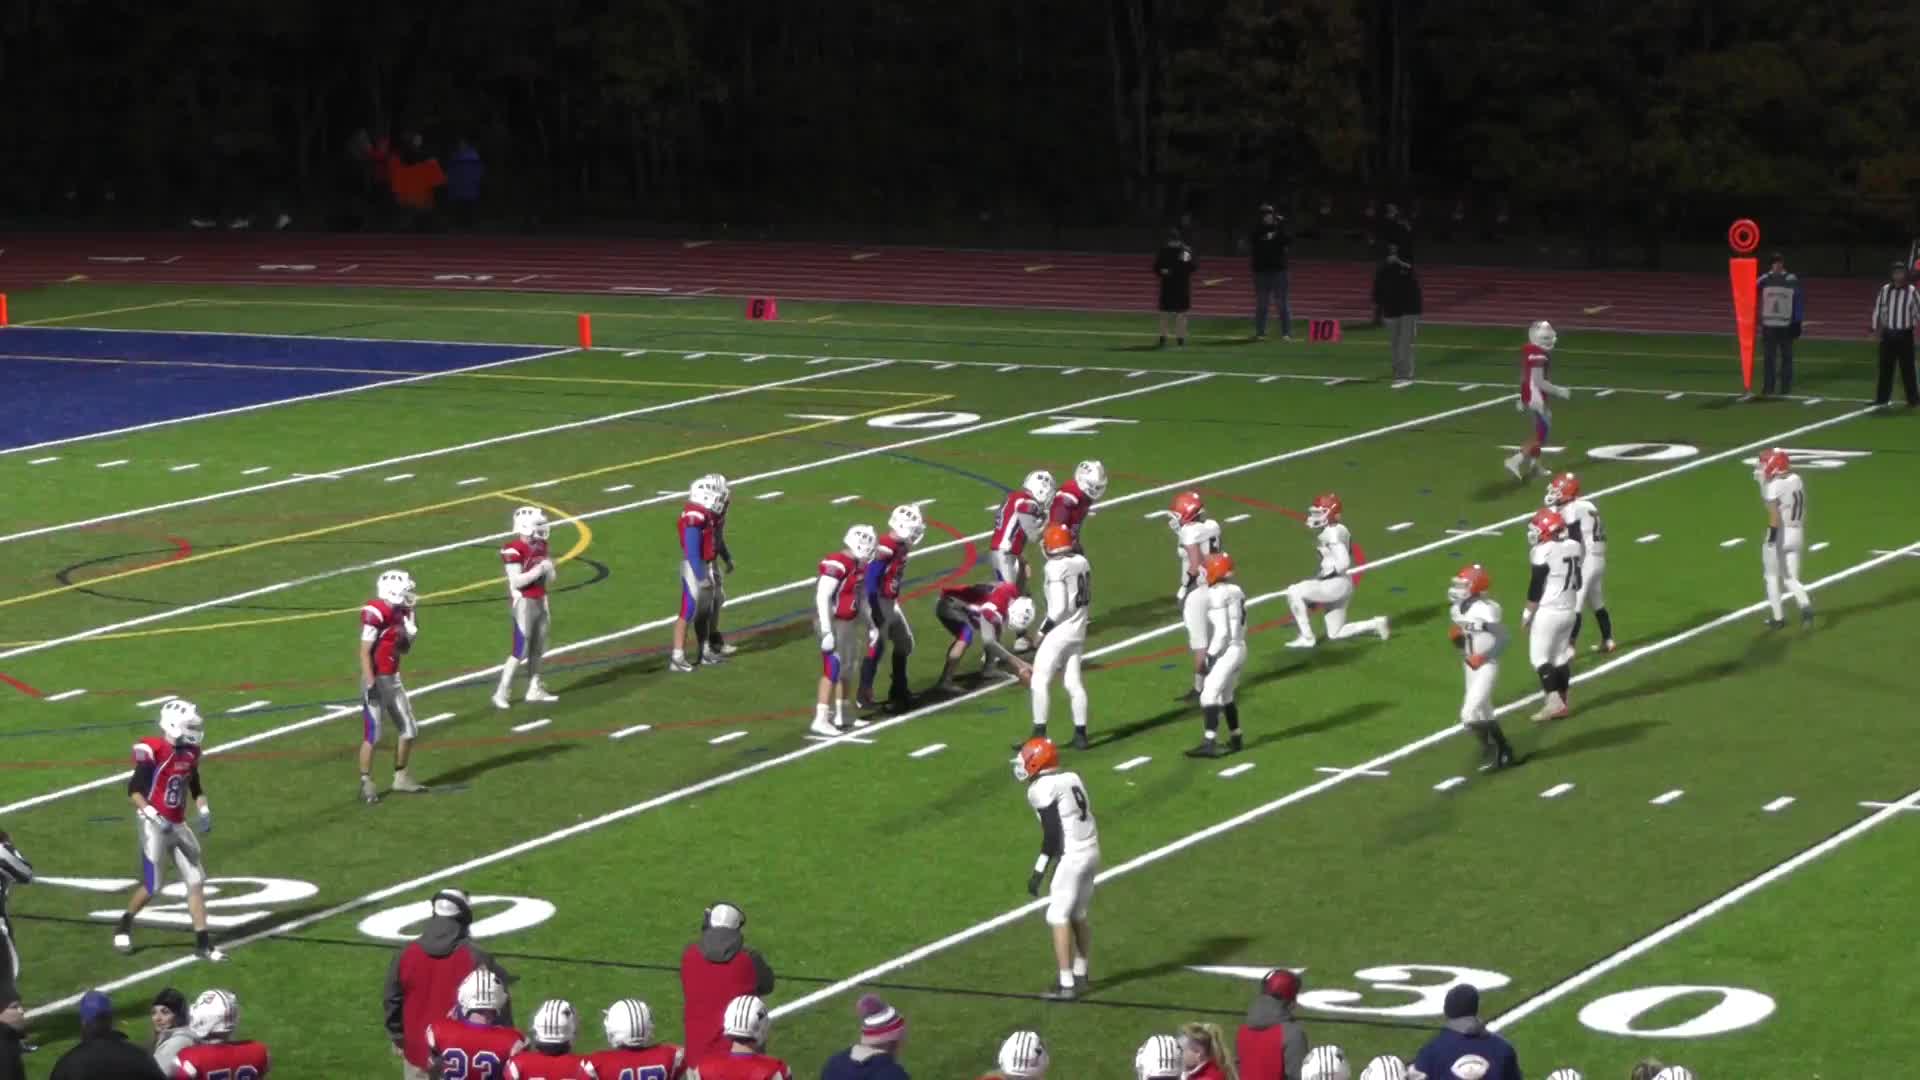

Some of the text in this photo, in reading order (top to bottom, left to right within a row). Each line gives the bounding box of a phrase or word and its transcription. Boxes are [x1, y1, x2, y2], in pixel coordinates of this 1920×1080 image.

[1314, 320, 1335, 340] 10
[1791, 490, 1803, 521] 11
[1562, 556, 1582, 592] 75
[1072, 785, 1087, 822] 9
